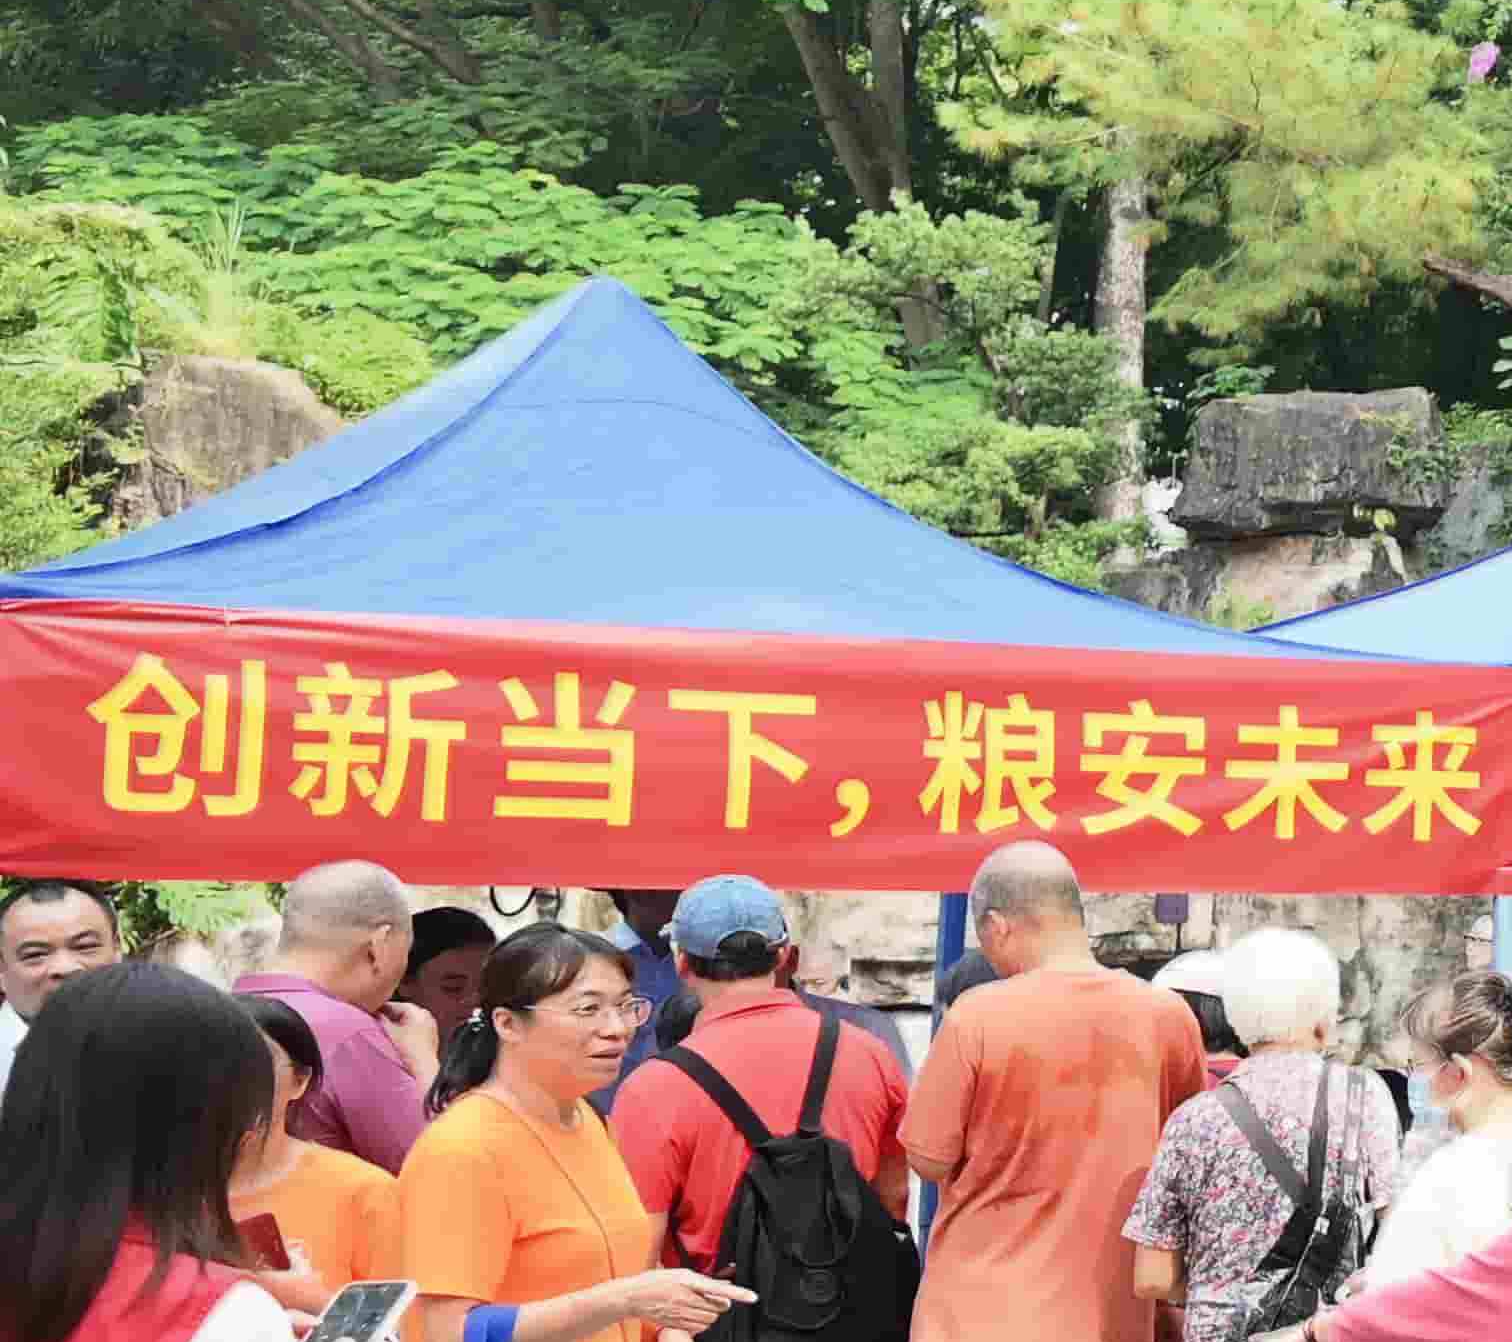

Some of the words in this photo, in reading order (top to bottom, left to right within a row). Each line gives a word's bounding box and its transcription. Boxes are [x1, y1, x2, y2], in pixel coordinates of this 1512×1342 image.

[86, 653, 1483, 843] 创新当下，粮安未来
